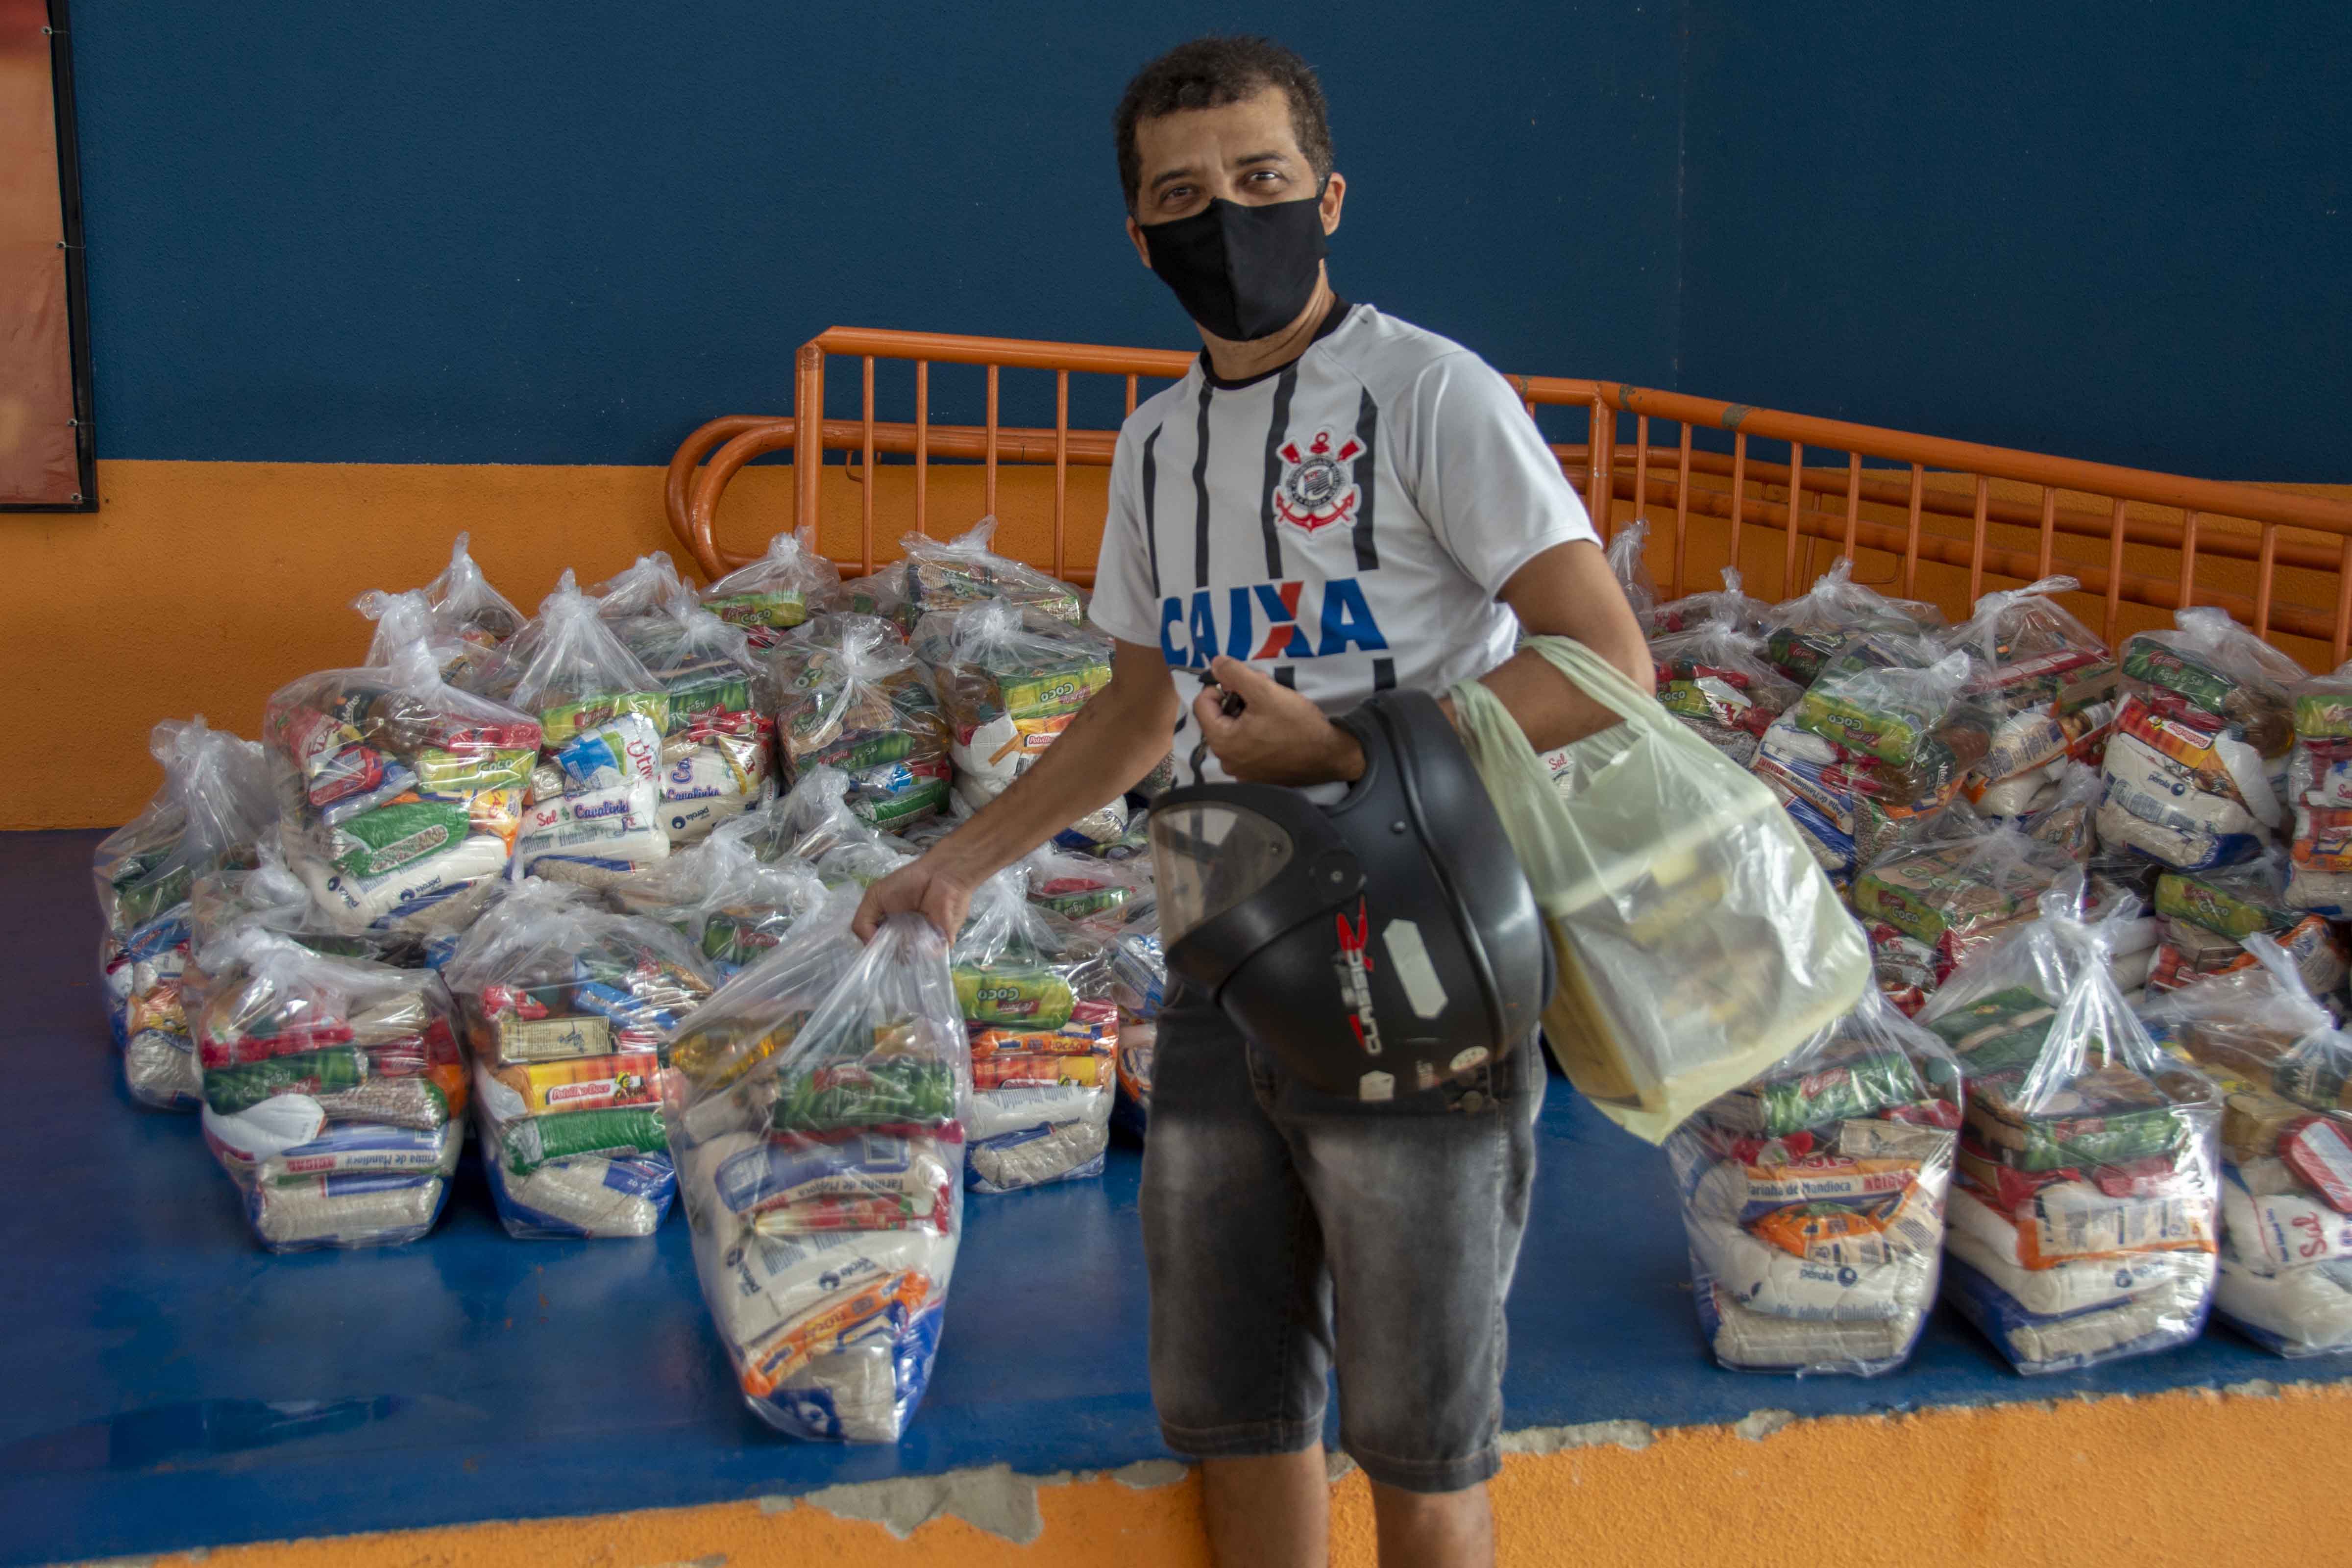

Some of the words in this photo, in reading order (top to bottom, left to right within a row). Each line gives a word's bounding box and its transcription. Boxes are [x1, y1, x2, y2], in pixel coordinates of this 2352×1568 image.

[740, 609, 772, 624] Coco
[1161, 578, 1389, 668] CAIXA
[1040, 682, 1074, 702] Coco
[1657, 690, 1686, 702] Coco
[1828, 714, 1862, 731] Coco
[865, 744, 878, 756] Sal
[478, 759, 513, 772] Coco
[1548, 753, 1568, 770] Sal
[537, 810, 558, 827] Sal
[1891, 906, 1920, 924] Coco
[977, 987, 1020, 1001] Coco
[1347, 948, 1382, 1056] CLASSIC
[552, 1085, 588, 1101] Polvilho
[588, 1083, 610, 1095] Doce
[1787, 1183, 1799, 1195] de
[2291, 1211, 2327, 1258] Sal
